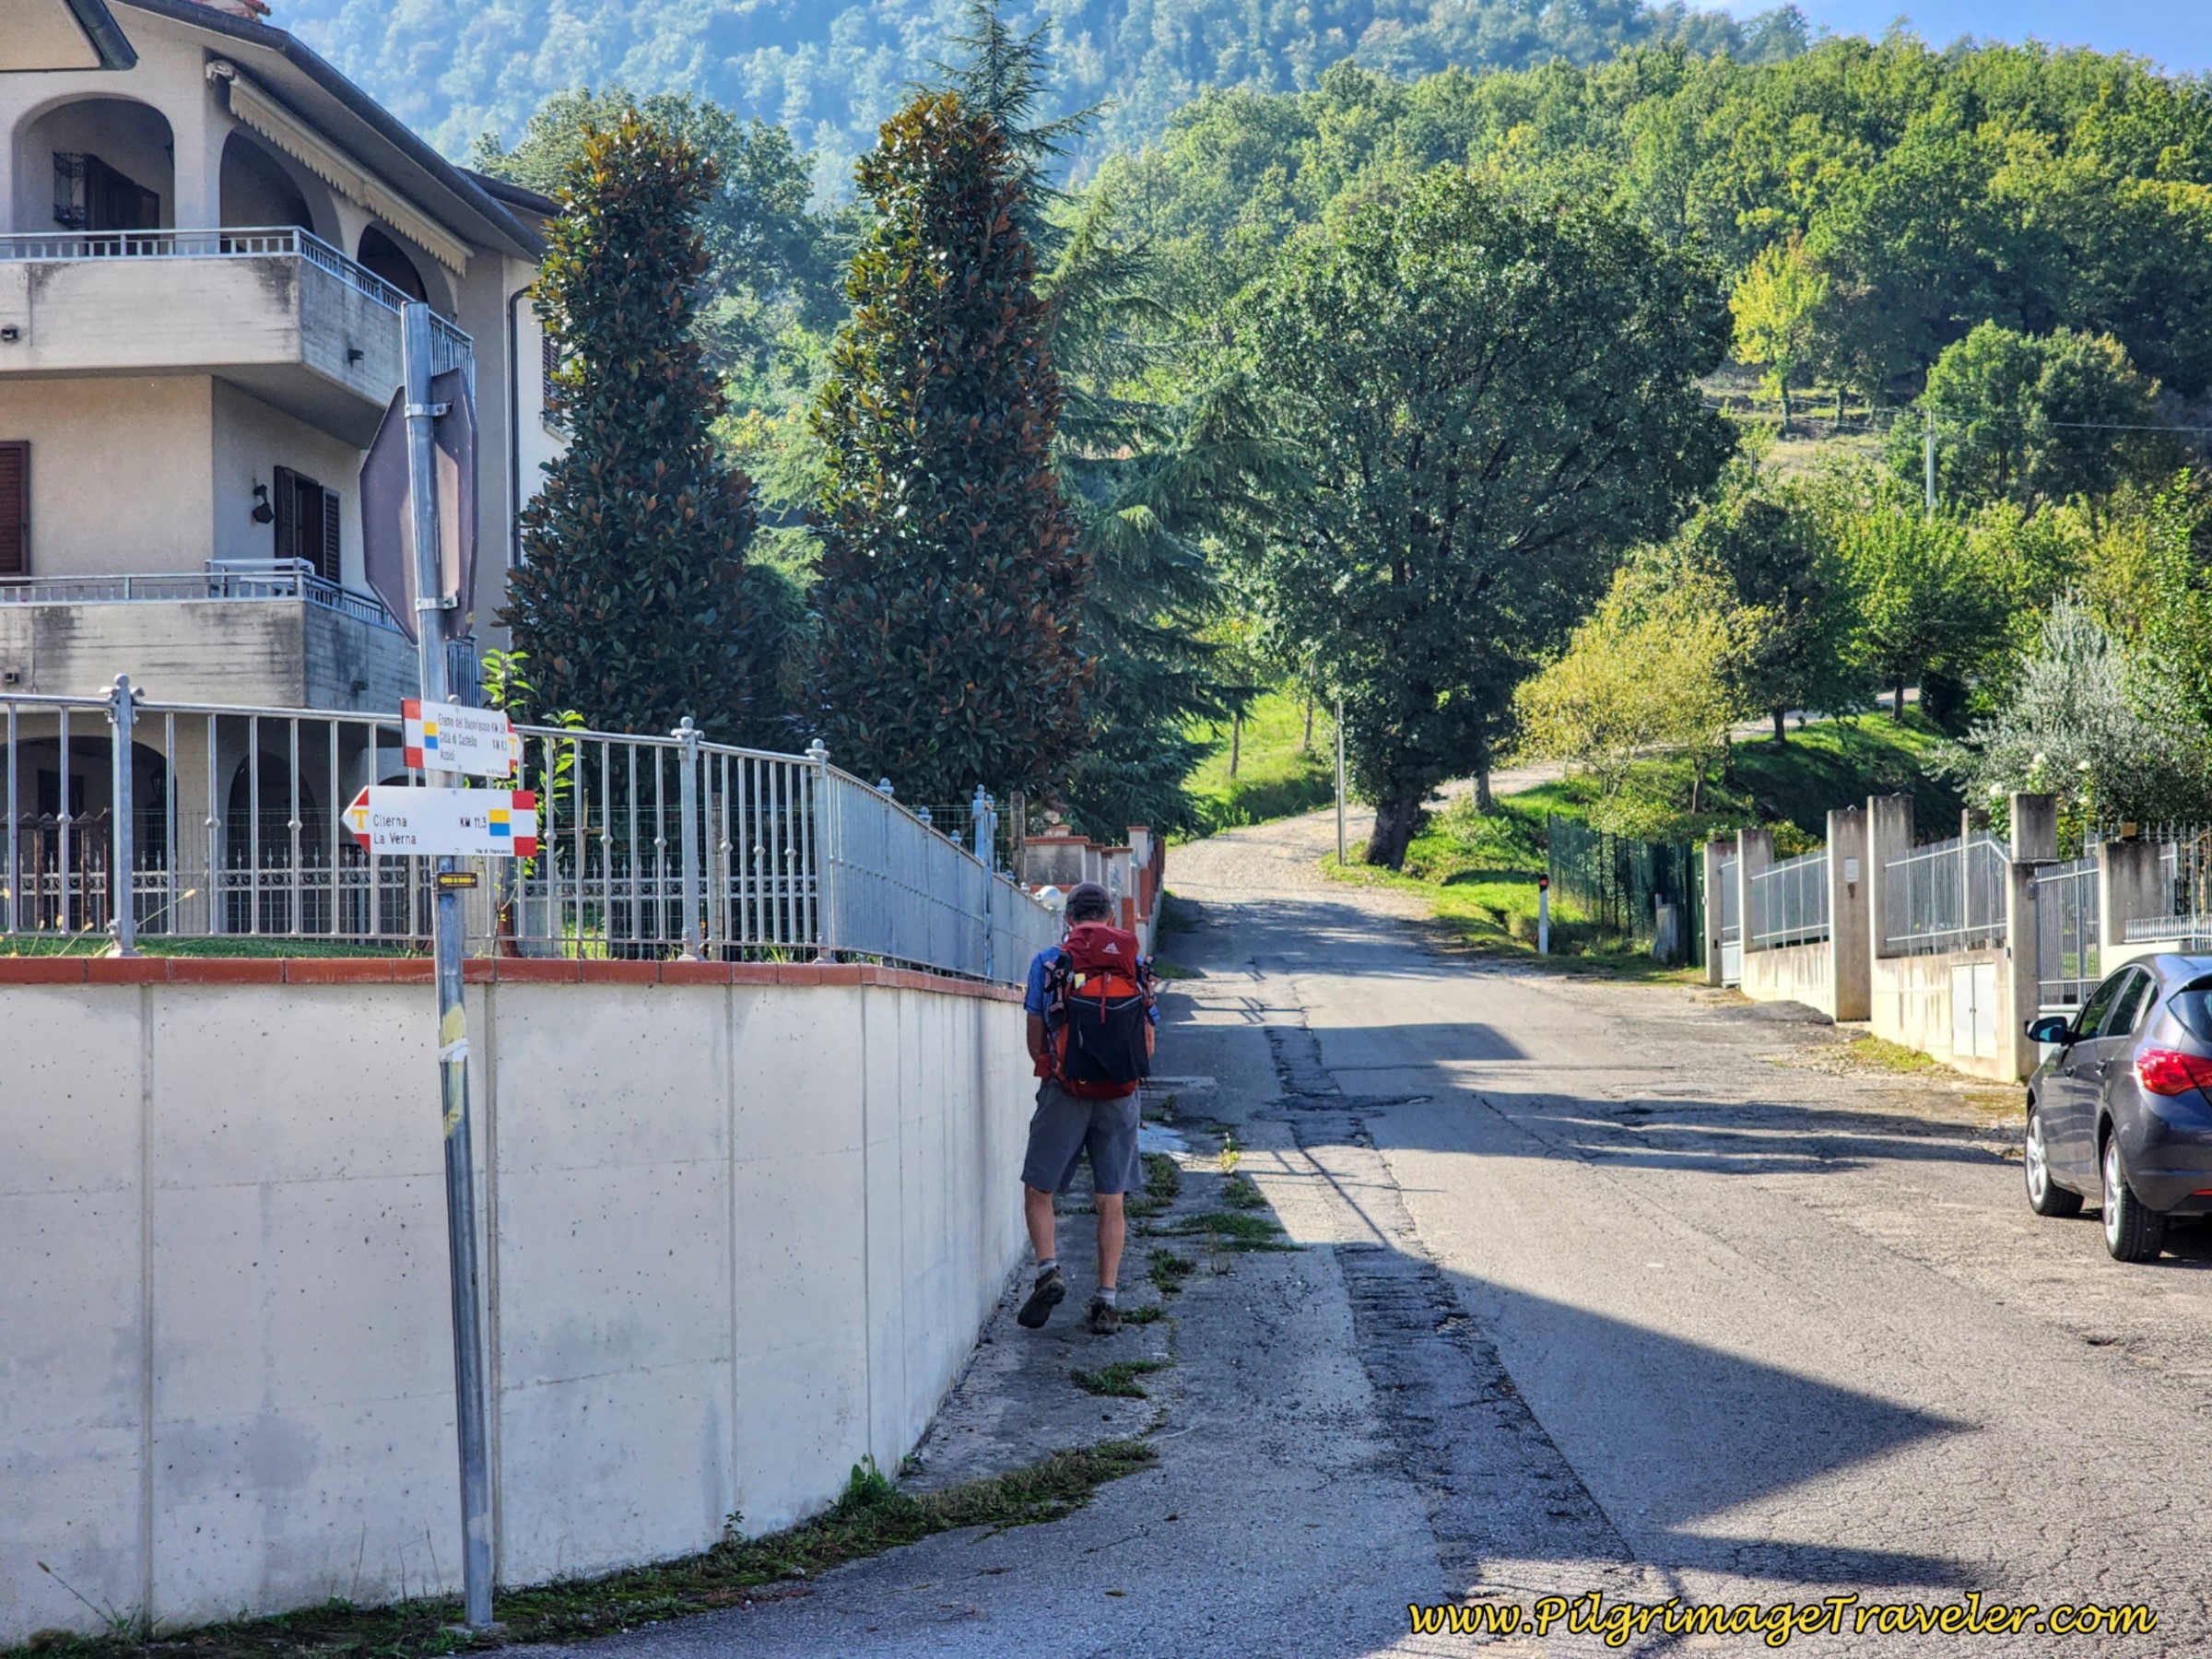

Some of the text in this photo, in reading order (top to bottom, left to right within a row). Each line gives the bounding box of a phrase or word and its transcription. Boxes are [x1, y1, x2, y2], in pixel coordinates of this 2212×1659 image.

[438, 712, 453, 727] Eremo
[455, 718, 464, 728] del
[491, 723, 499, 733] KM
[452, 734, 457, 745] di
[459, 734, 477, 748] Castello
[493, 739, 500, 750] KM
[373, 814, 407, 828] Citerna
[459, 817, 471, 828] KM
[373, 832, 417, 845] La Verna
